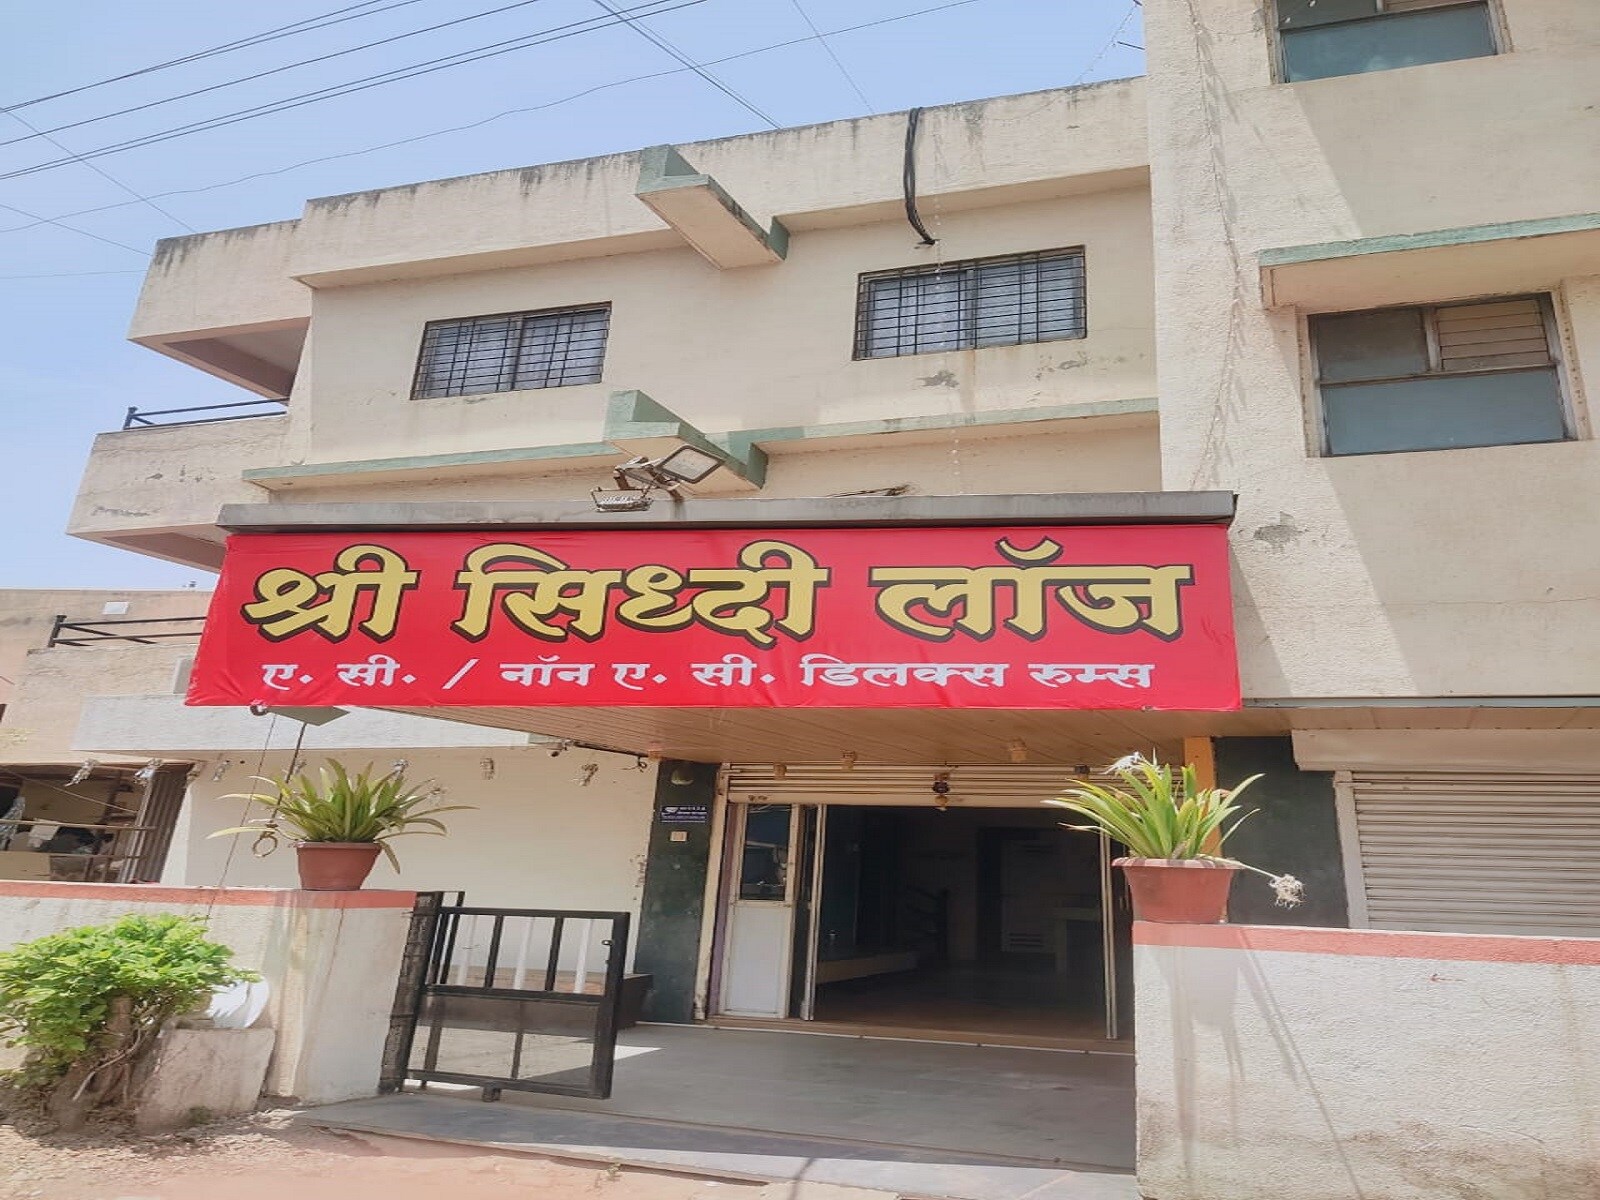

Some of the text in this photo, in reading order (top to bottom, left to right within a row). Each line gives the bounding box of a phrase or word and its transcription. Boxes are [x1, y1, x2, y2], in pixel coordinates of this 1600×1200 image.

[241, 537, 1195, 649] श्री सिध्दी लॉज
[262, 664, 313, 691] ए.
[336, 654, 416, 687] सी.
[500, 655, 595, 687] नॉन
[612, 663, 667, 691] ए.
[692, 654, 776, 687] सी.
[799, 653, 1010, 688] डिलक्स
[1028, 663, 1155, 689] रुम्स
